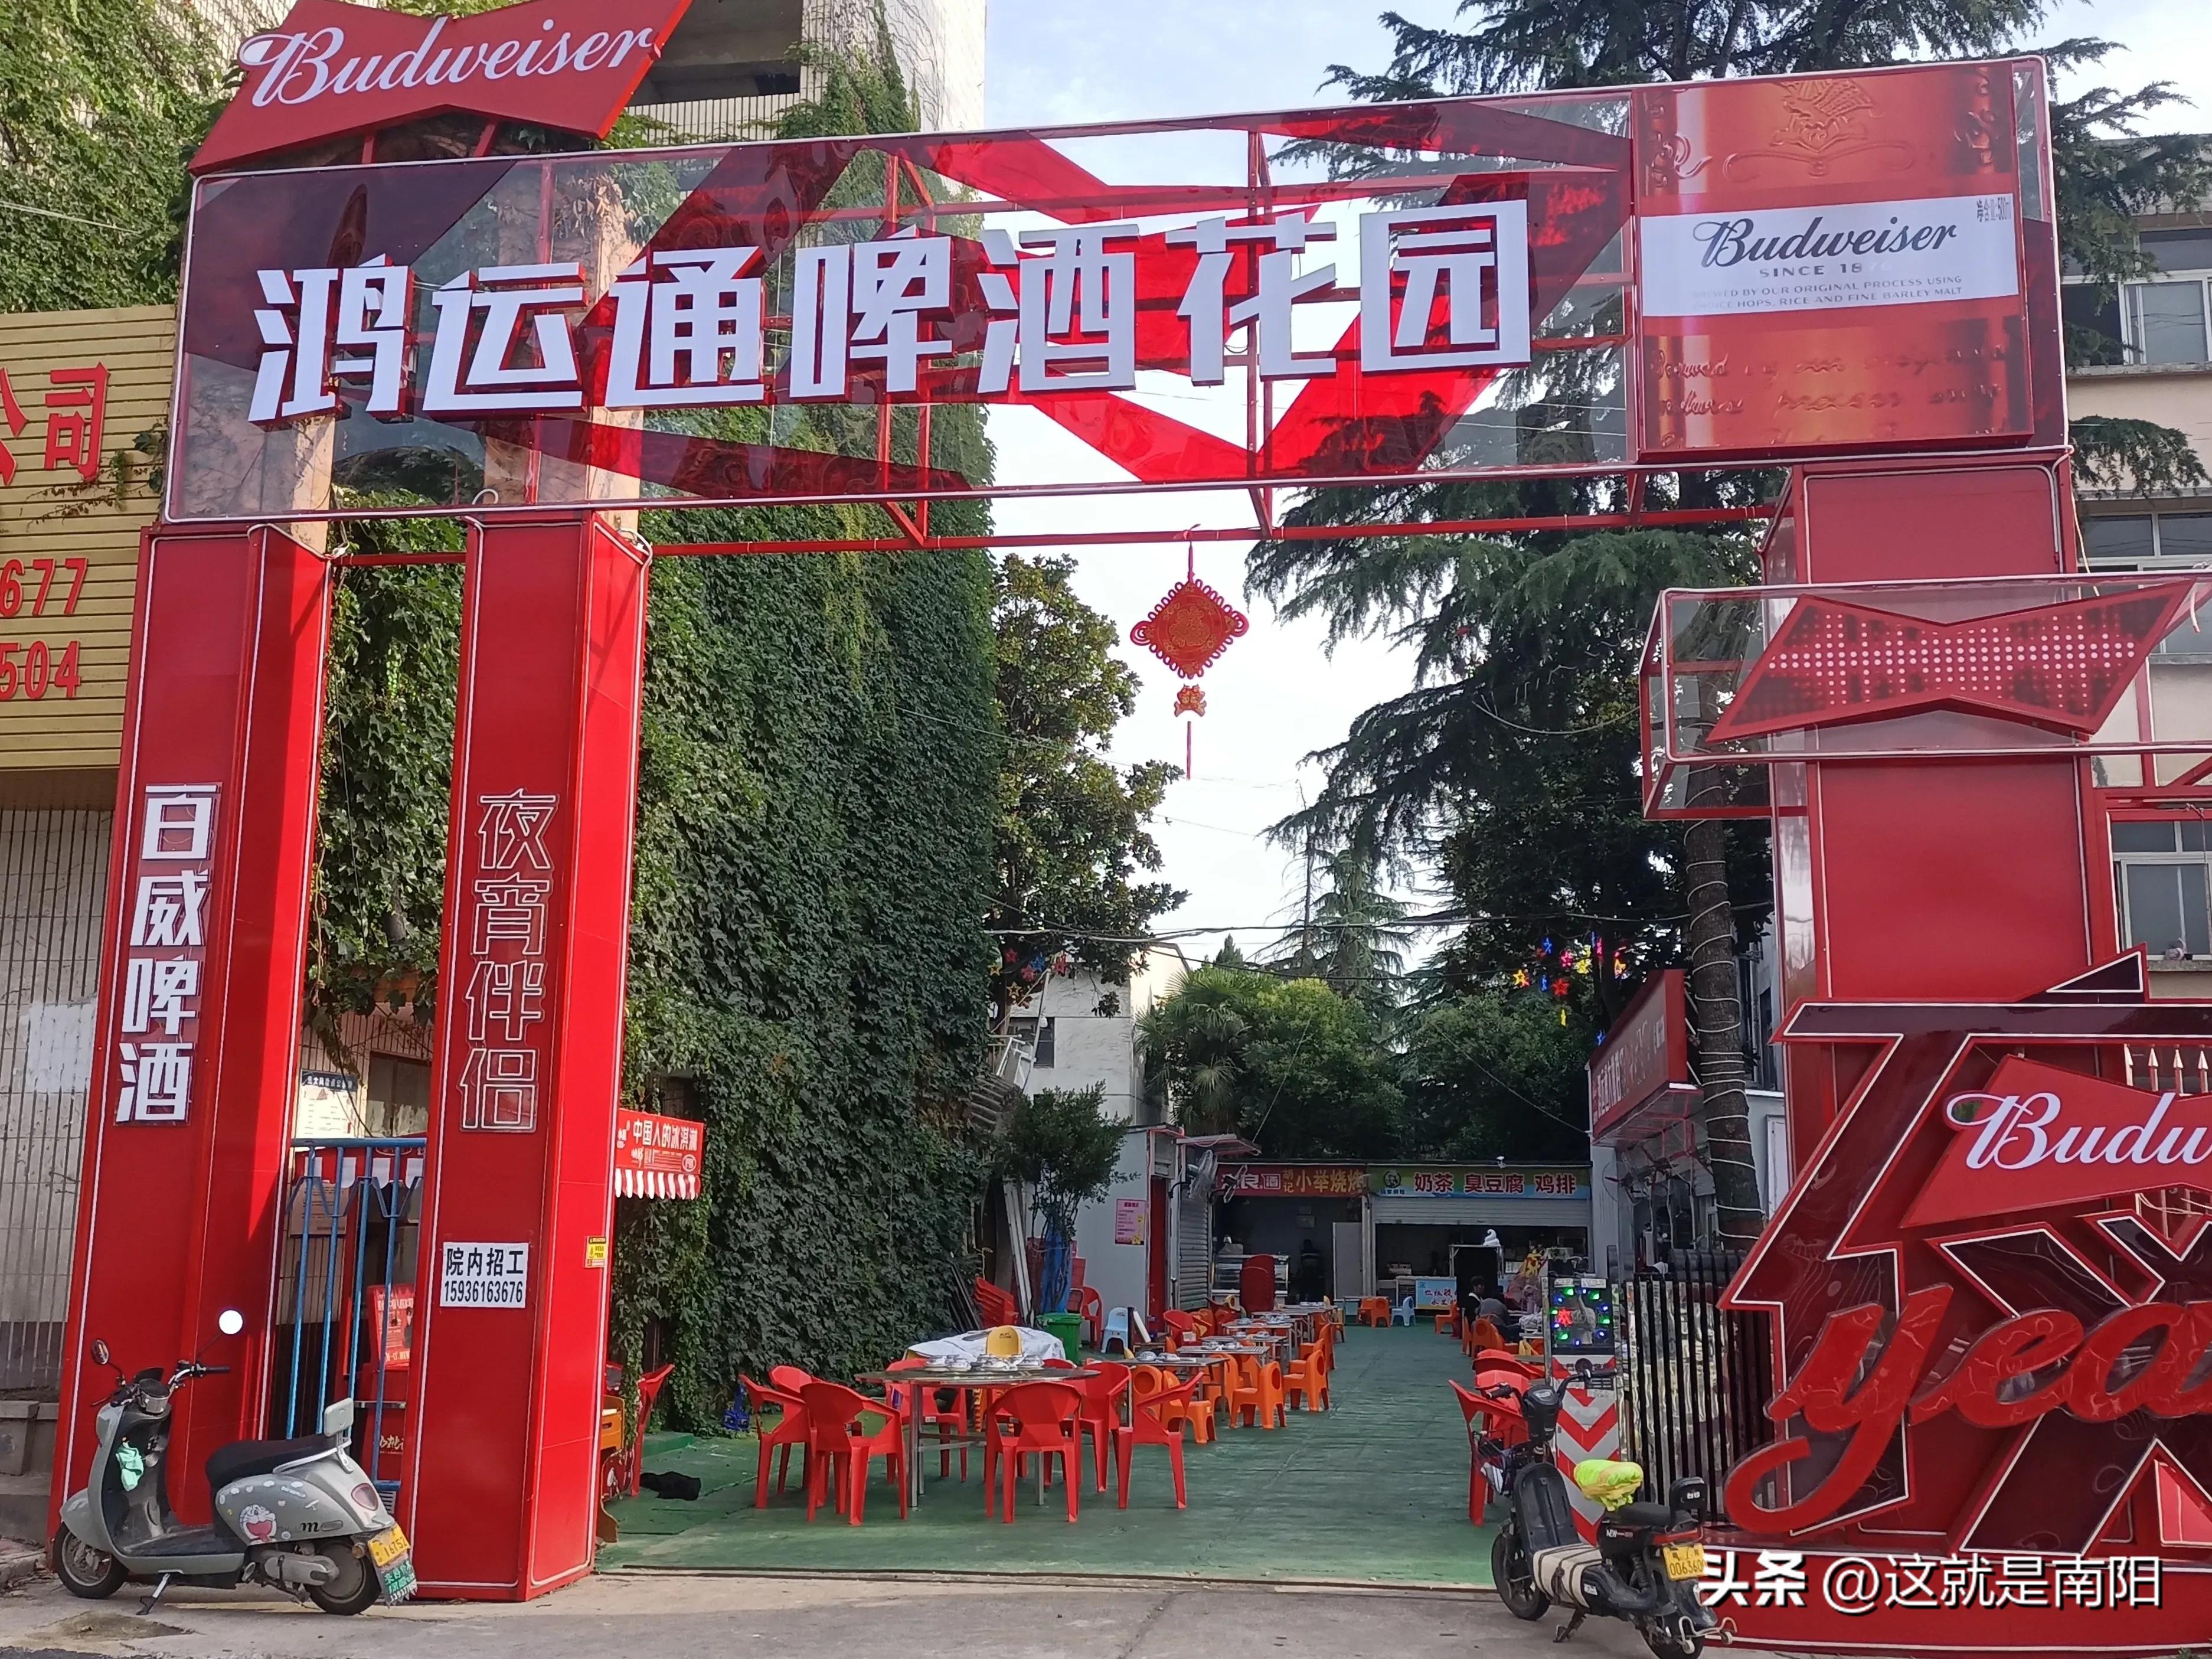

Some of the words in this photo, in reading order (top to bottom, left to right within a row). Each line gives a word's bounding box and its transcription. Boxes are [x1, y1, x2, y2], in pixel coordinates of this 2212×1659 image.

[240, 16, 658, 107] Budweiser
[1693, 216, 1957, 267] Budweiser
[1759, 264, 1825, 278] SINCE
[1795, 283, 1859, 293] ORIGINAL
[1864, 279, 1922, 289] PROCESS
[1927, 276, 1962, 285] USING
[1779, 296, 1811, 305] RICE
[1815, 294, 1843, 303] AND
[1848, 292, 1877, 301] FINE
[1883, 289, 1930, 299] BARLEY
[1934, 286, 1962, 296] MALT
[248, 198, 1531, 425] 鸿运通啤酒花园
[116, 785, 220, 1122] 百威啤酒
[460, 788, 560, 1129] 夜宵伴侣
[633, 1118, 698, 1151] 中国人的冰淇淋
[1414, 1173, 1453, 1193] 奶茶
[1464, 1174, 1524, 1194] 臭豆腐
[1534, 1174, 1576, 1195] 鸡排
[446, 1247, 524, 1276] 院内招工
[445, 1280, 523, 1303] 15936163676
